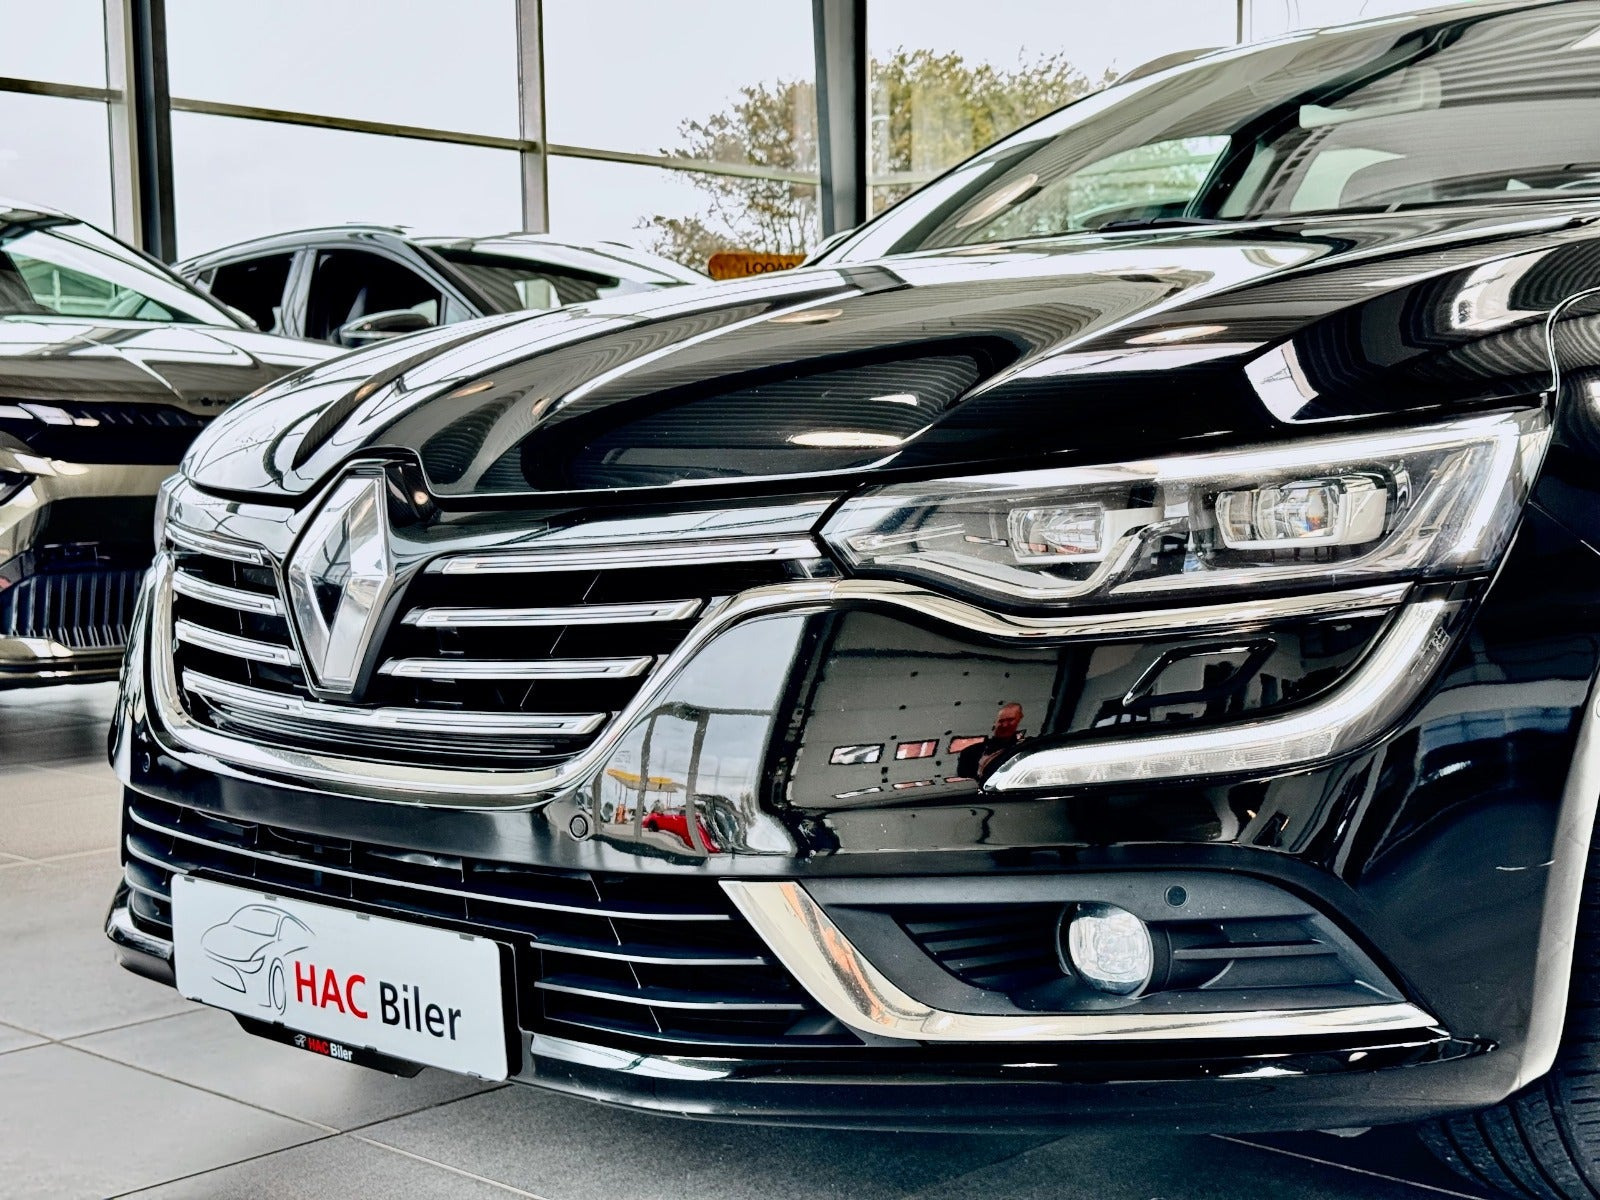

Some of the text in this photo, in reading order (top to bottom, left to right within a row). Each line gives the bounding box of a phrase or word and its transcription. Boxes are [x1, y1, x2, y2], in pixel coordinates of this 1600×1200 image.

[294, 960, 462, 1041] HAC Biler
[307, 1037, 353, 1061] HAC Biler
